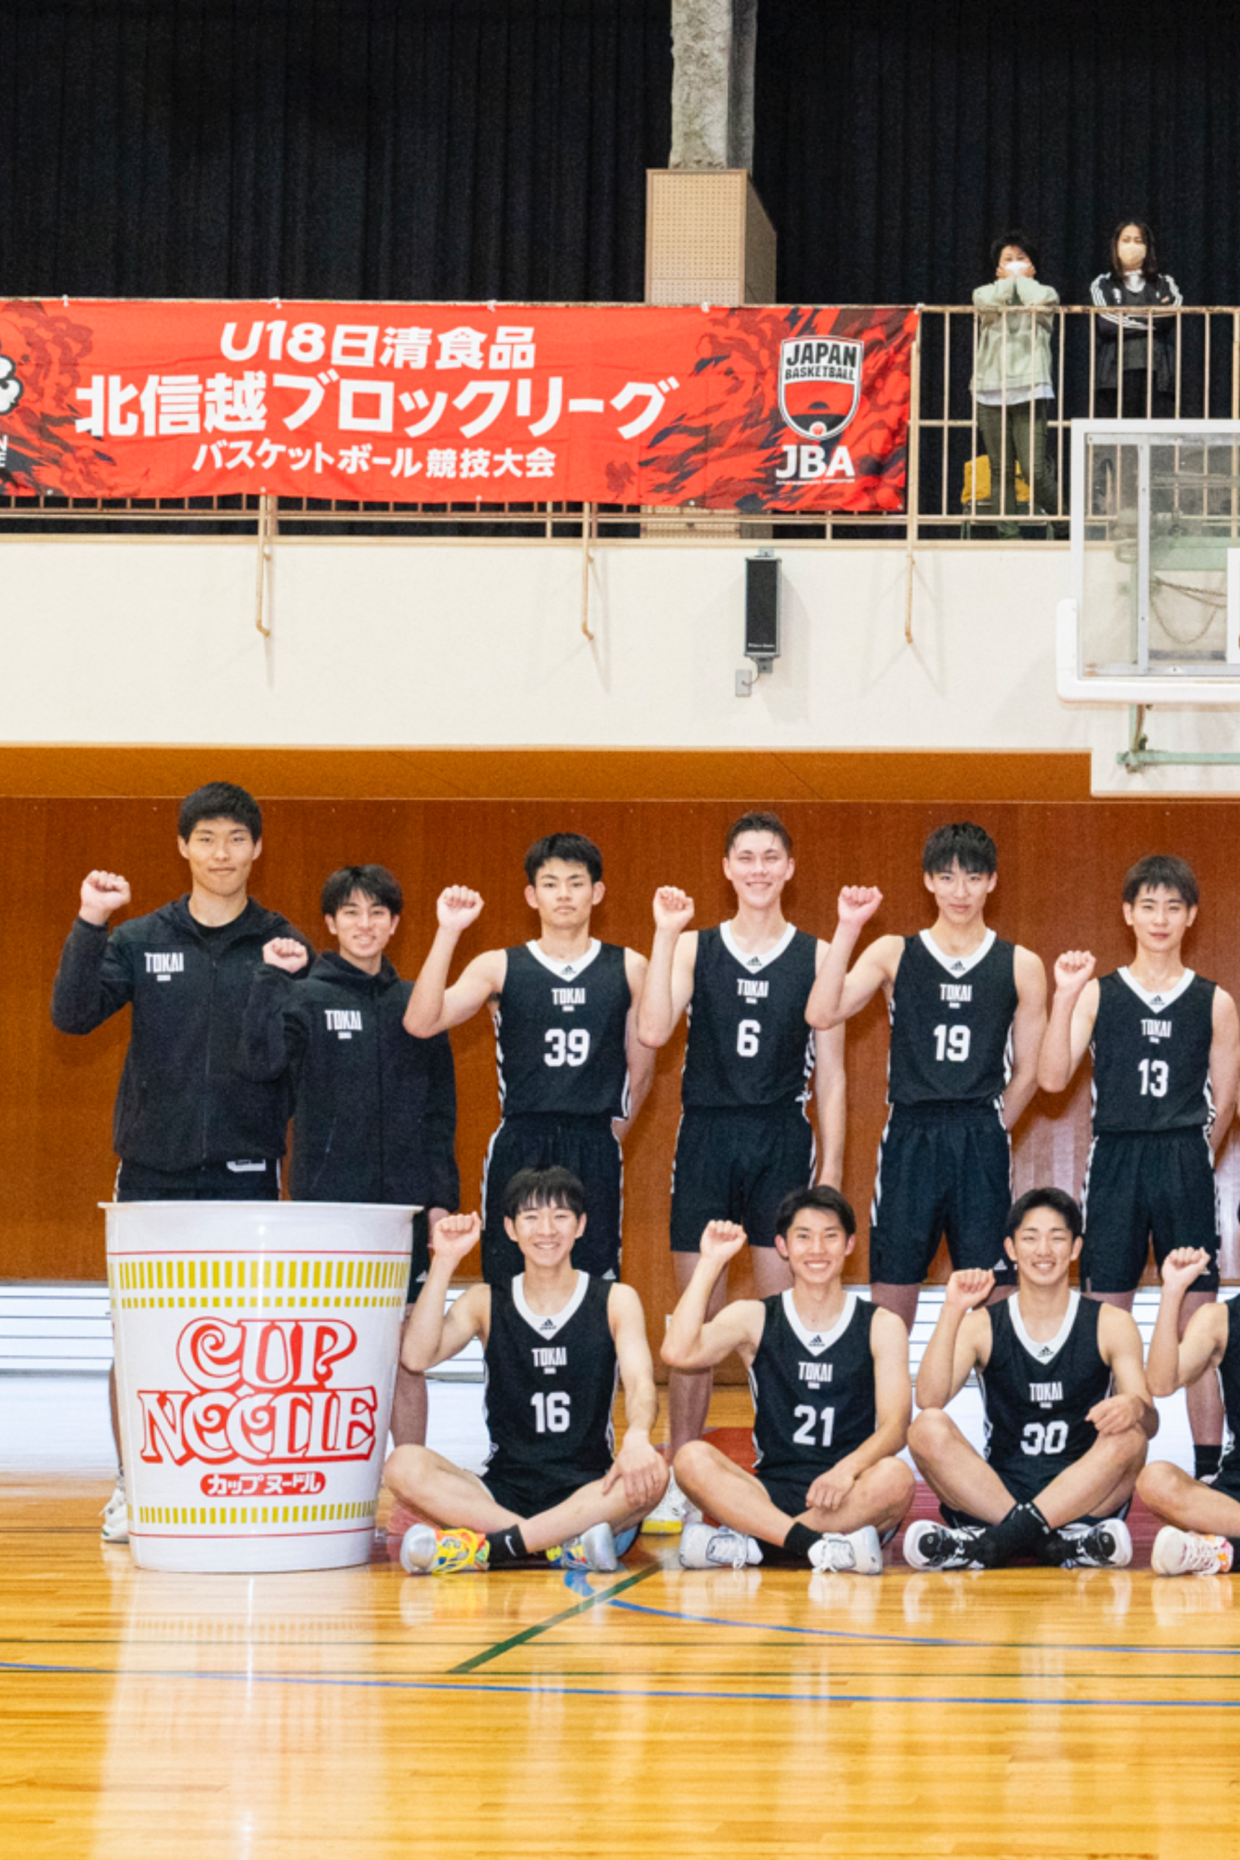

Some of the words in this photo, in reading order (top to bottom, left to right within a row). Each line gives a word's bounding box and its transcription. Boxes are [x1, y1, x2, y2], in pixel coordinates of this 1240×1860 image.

[221, 320, 536, 369] U18日清食品
[786, 342, 857, 368] JAPAN
[785, 365, 855, 380] BASKETBALL
[75, 369, 679, 440] 北信越ブロックリーグ
[193, 438, 556, 478] バスケットボール競技大会
[775, 445, 855, 478] JBA
[144, 952, 184, 973] TOKAI
[552, 988, 586, 1005] TOKAI
[737, 979, 769, 999] TOKAI
[940, 984, 973, 1002] TOKAI
[325, 1010, 363, 1031] TOKAI
[1141, 1019, 1172, 1038] TOKAI
[544, 1029, 590, 1067] 39
[737, 1019, 761, 1057] 6
[933, 1025, 971, 1062] 19
[1138, 1059, 1169, 1098] 13
[176, 1316, 358, 1390] CUP
[532, 1347, 567, 1368] TOKAI
[798, 1362, 832, 1384] TOKAI
[1029, 1382, 1062, 1402] TOKAI
[530, 1392, 571, 1433] 16
[793, 1405, 834, 1447] 21
[1020, 1420, 1069, 1456] 30
[207, 1474, 322, 1494] カップヌードル
